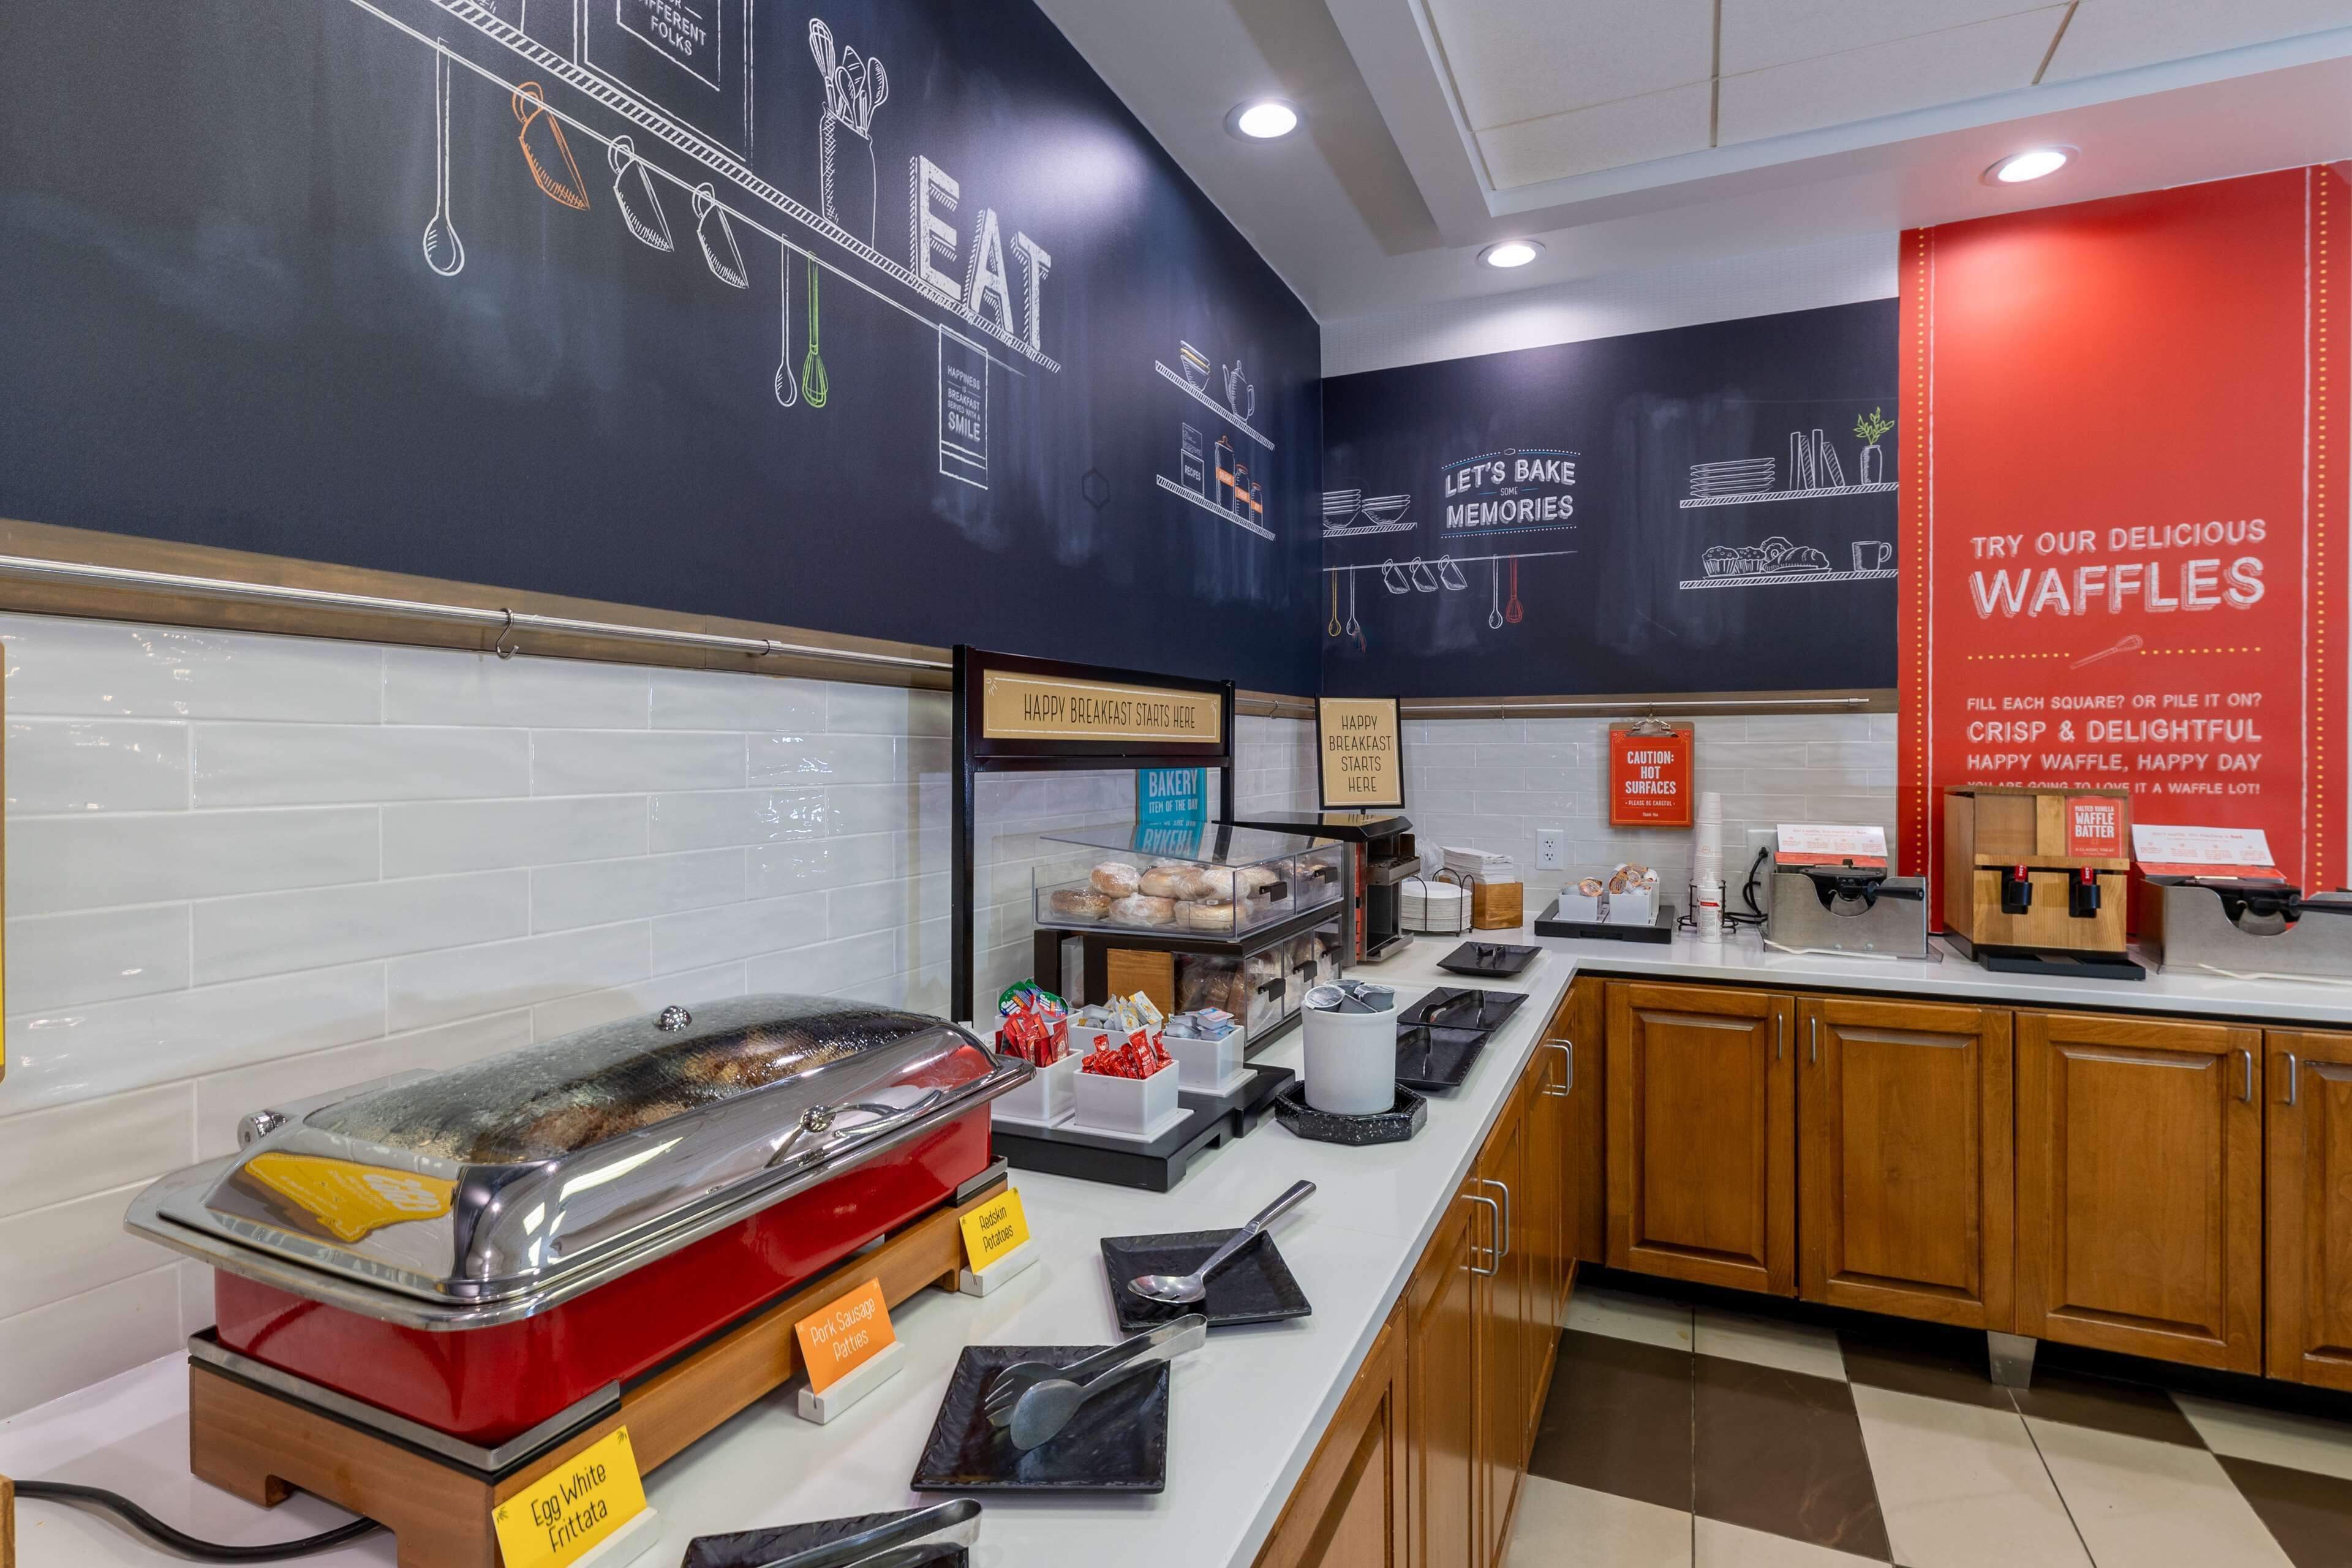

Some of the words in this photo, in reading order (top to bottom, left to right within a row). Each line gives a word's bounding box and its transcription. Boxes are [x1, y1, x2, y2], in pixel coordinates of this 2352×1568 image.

[651, 15, 692, 56] FOLKS
[910, 154, 1051, 351] EAT
[948, 365, 980, 390] HAPPINESS
[948, 388, 980, 411] BREAKFAST
[948, 400, 965, 413] SERVED
[965, 409, 976, 420] WITH
[948, 411, 981, 442] SMILE
[1184, 465, 1201, 481] RECIPES
[1446, 461, 1506, 497] LET'S
[1515, 459, 1576, 485] BAKE
[1500, 486, 1518, 496] SOME
[1446, 495, 1574, 528] MEMORIES
[1970, 534, 2024, 559] TRY
[2035, 530, 2096, 556] OUR
[2108, 519, 2266, 551] DELICIOUS
[1969, 556, 2265, 619] WAFFLES
[1024, 693, 1065, 722] HAPPY
[1071, 697, 1132, 725] BREAKFAST
[1136, 703, 1170, 727] STARTS
[1173, 706, 1195, 728] HERE
[1967, 698, 1996, 710] FILL
[2002, 696, 2045, 710] EACH
[2051, 695, 2125, 709] SQUARE?
[2132, 695, 2156, 708] OR
[2163, 693, 2198, 708] PILE
[2205, 693, 2220, 707] IT
[2227, 692, 2262, 707] ON?
[1341, 715, 1378, 730] HAPPY
[1967, 721, 2046, 744] CRISP
[2058, 720, 2076, 743] &
[2087, 718, 2262, 743] DELIGHTFUL
[1329, 736, 1392, 751] BREAKFAST
[1341, 756, 1381, 771] STARTS
[1627, 751, 1674, 764] CAUTION:
[1967, 754, 2032, 771] HAPPY
[2040, 754, 2128, 772] WAFFLE,
[2137, 754, 2209, 771] HAPPY
[2217, 753, 2262, 771] DAY
[1149, 769, 1197, 797] BAKERY
[1348, 777, 1377, 792] HERE
[1640, 766, 1660, 779] HOT
[1626, 781, 1676, 794] SURFACES
[2135, 783, 2146, 793] IT
[2152, 783, 2162, 793] A
[2168, 783, 2223, 794] WAFFLE
[2228, 783, 2260, 794] LOT!
[1149, 802, 1163, 813] ITEM
[1166, 801, 1172, 812] OF
[1175, 799, 1186, 811] THE
[1188, 799, 1198, 810] DAY
[2075, 812, 2114, 825] WAFFLE
[2075, 825, 2114, 838] BATTER
[979, 1205, 1008, 1231] Redskin
[982, 1225, 1014, 1253] Potatoes
[810, 1319, 837, 1348] Pork
[836, 1298, 875, 1332] Sausage
[833, 1330, 869, 1362] Patties
[531, 1494, 561, 1527] Egg
[560, 1464, 606, 1506] White
[549, 1499, 608, 1553] Frittata
